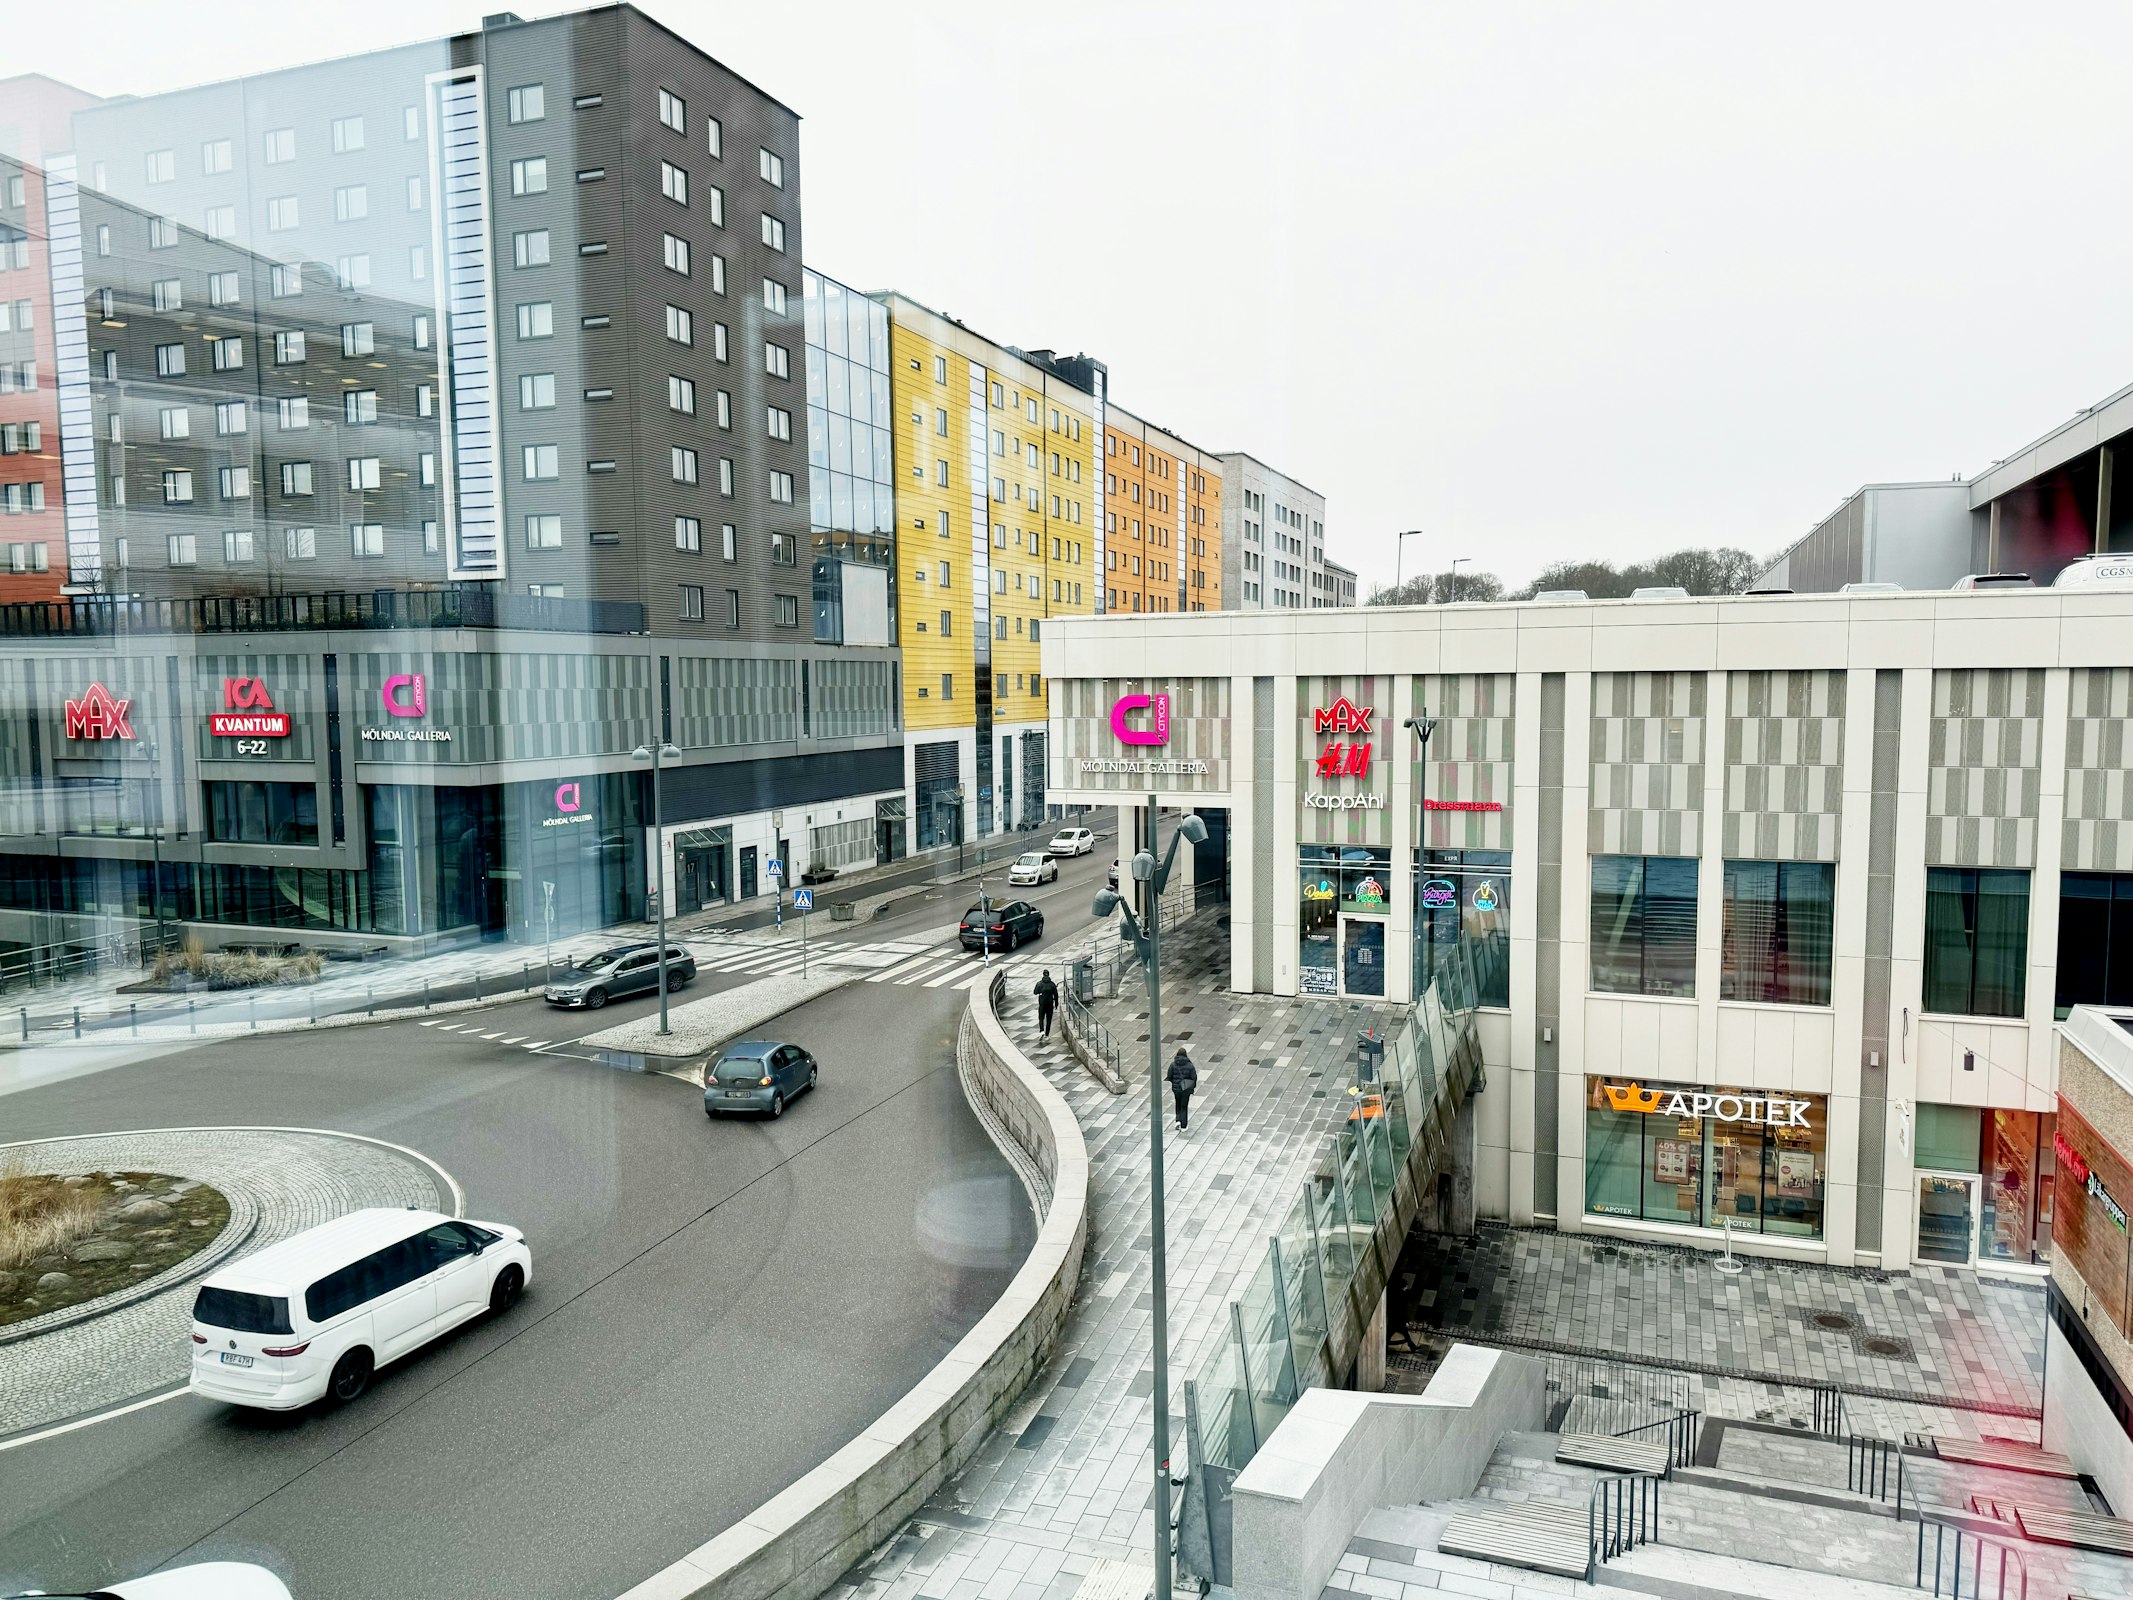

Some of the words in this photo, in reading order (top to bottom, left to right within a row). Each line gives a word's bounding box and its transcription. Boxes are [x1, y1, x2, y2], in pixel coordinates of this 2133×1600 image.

[224, 676, 274, 709] ICA
[65, 681, 137, 740] MAX
[1158, 697, 1166, 732] CITYCON
[1314, 696, 1374, 733] MAX
[215, 717, 284, 732] KVANTUM
[361, 728, 406, 741] MÖLNDAL
[407, 730, 452, 741] GALLERIA
[1147, 762, 1209, 774] GALLERIA
[1315, 741, 1373, 781] H&M
[1304, 791, 1384, 812] KappAhl
[1423, 799, 1503, 812] Dressmann
[687, 862, 695, 873] 17
[1665, 1091, 1812, 1128] APOTEK
[1604, 1206, 1633, 1215] APOTEK
